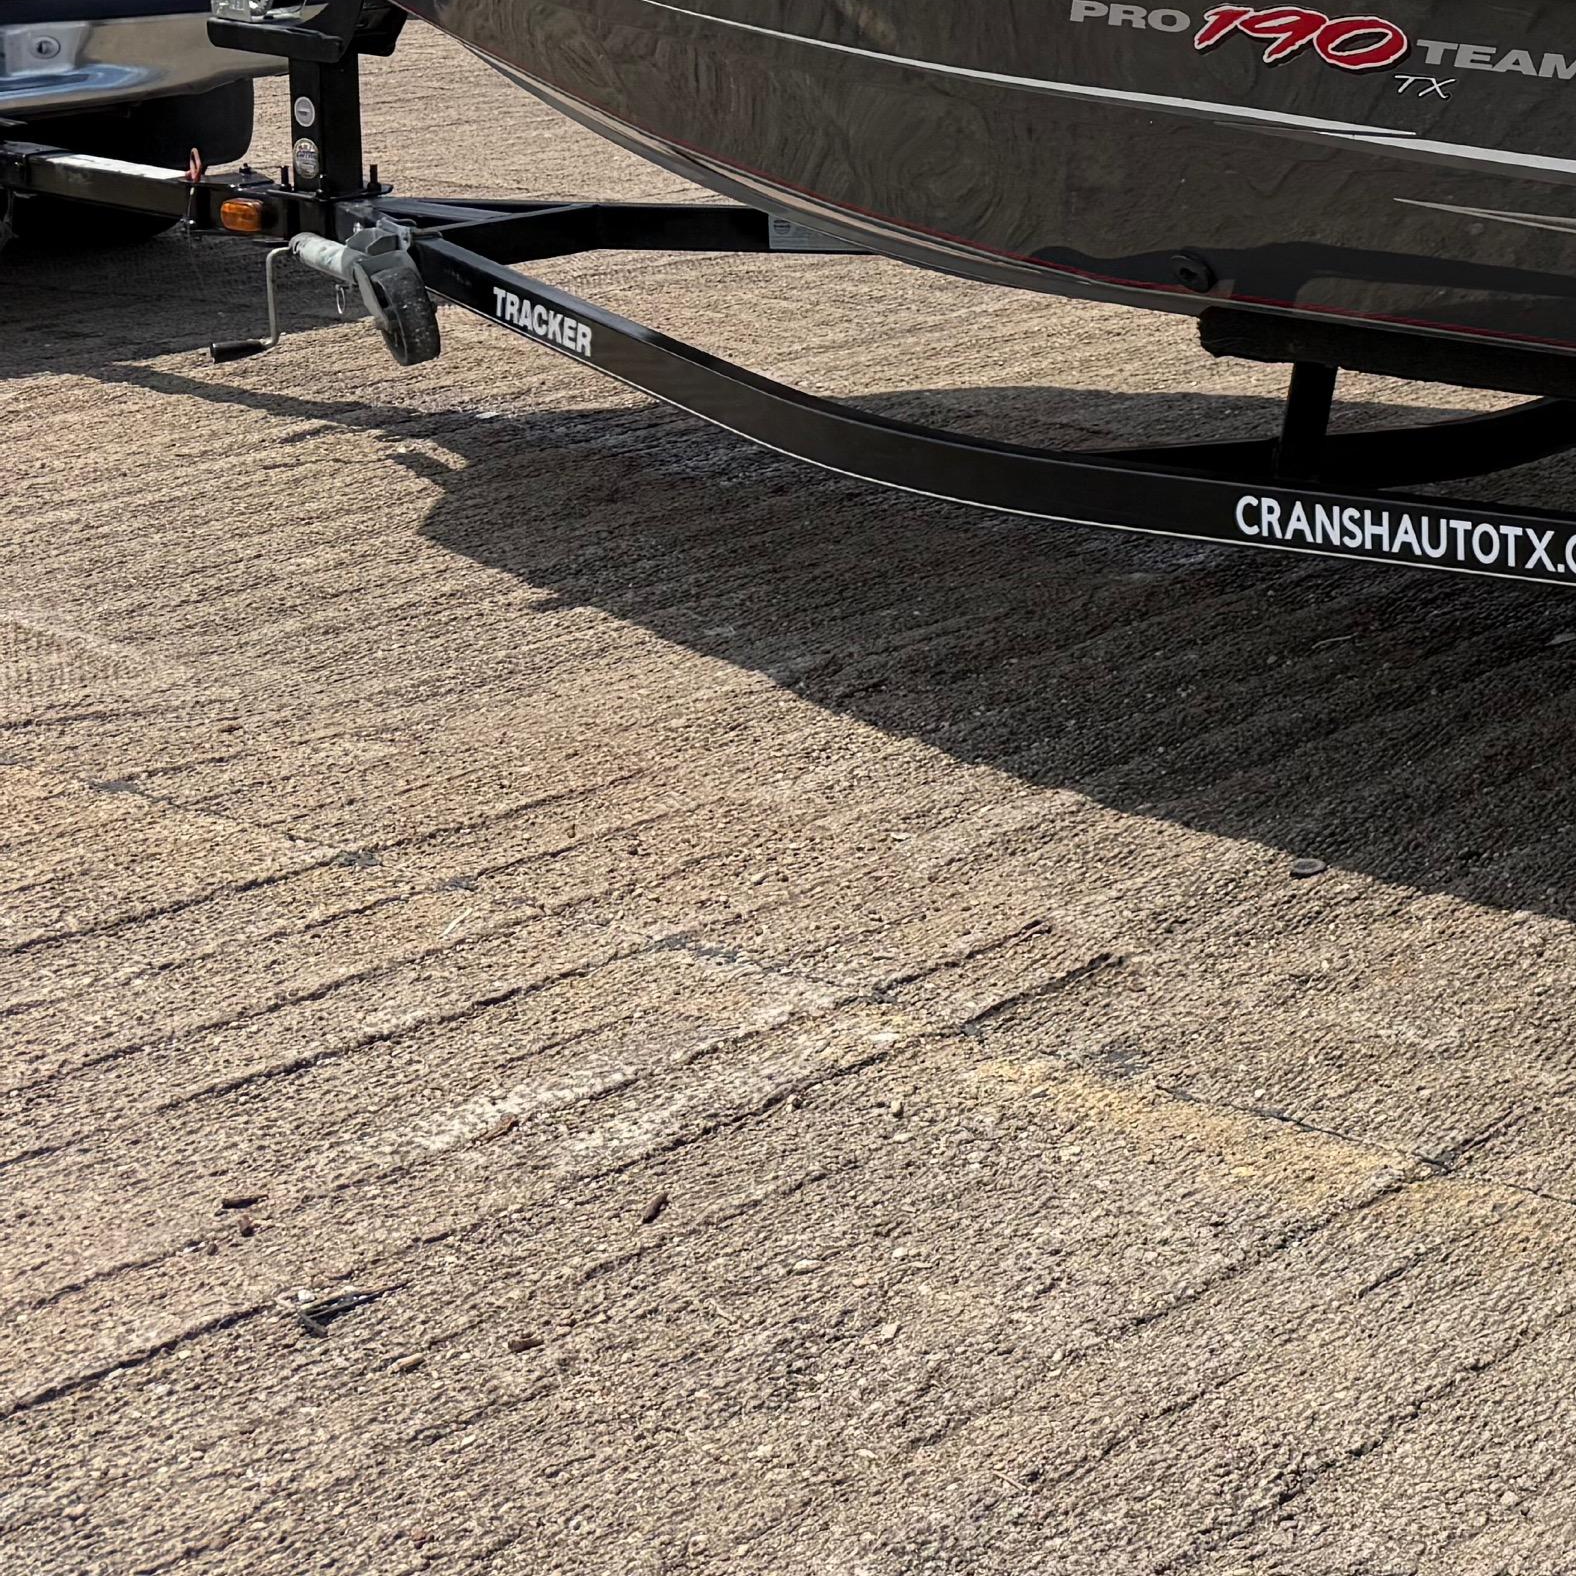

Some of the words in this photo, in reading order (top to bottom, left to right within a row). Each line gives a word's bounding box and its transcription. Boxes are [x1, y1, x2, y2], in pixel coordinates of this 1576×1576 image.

[1193, 3, 1410, 71] 190
[1394, 74, 1456, 100] TX
[491, 286, 593, 357] TRACKER
